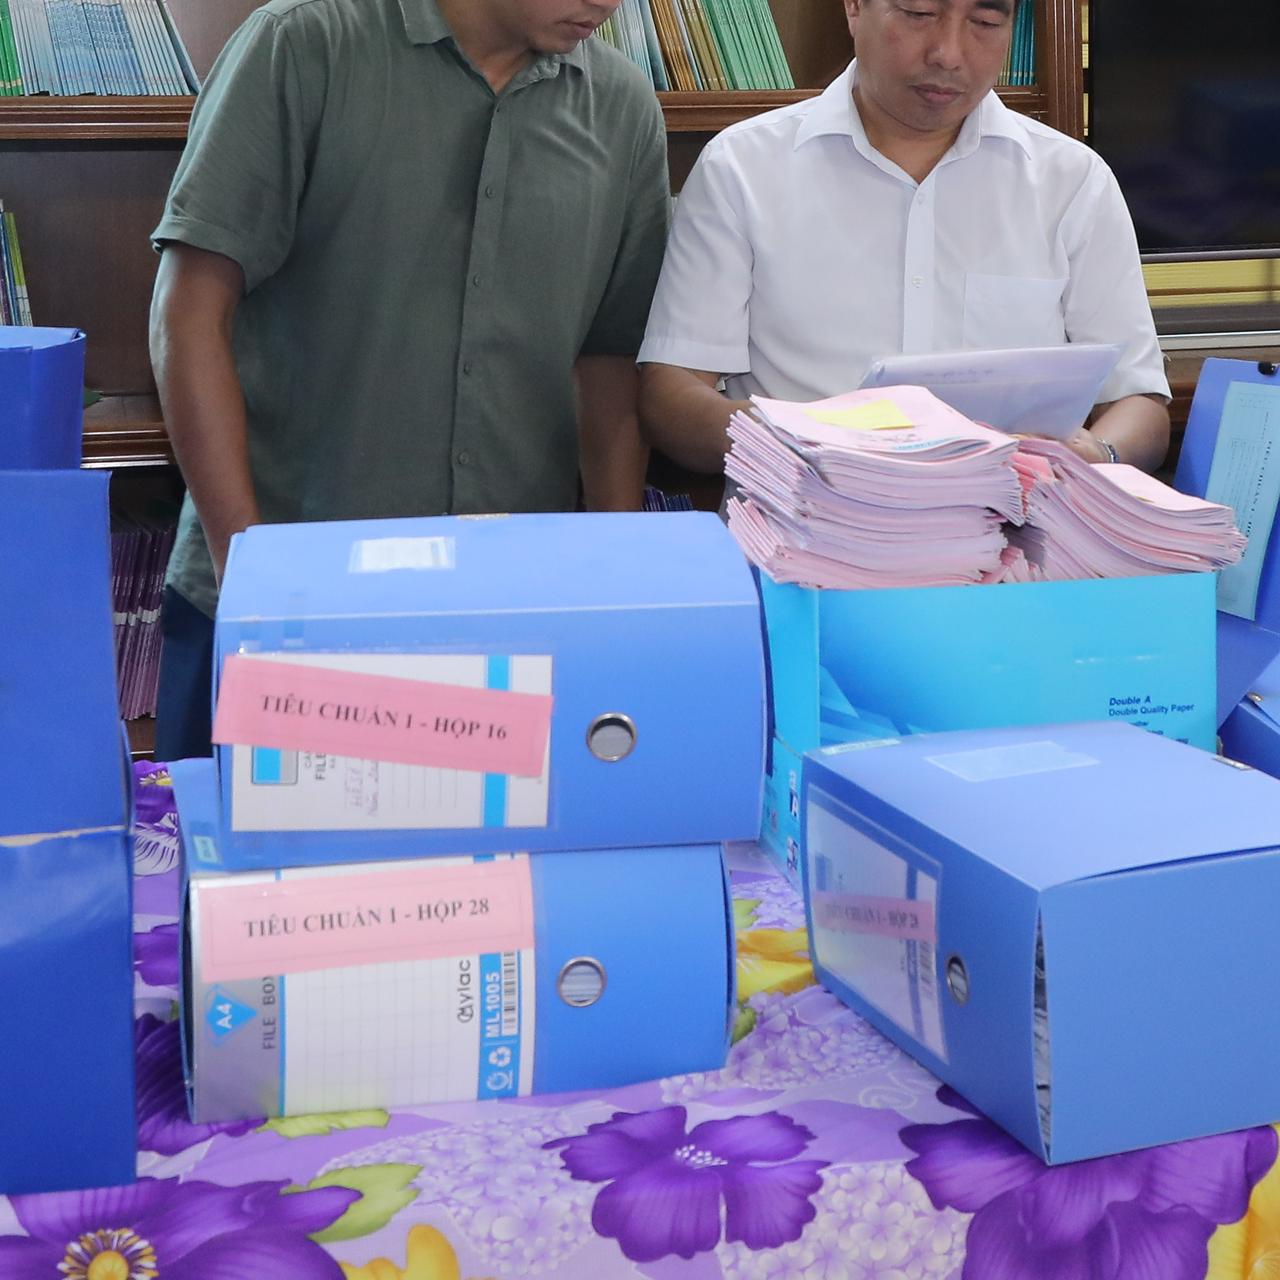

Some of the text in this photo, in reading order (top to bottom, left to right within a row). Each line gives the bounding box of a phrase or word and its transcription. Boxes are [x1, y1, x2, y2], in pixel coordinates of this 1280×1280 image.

[260, 693, 311, 716] TIÊU
[434, 717, 480, 738] HỘP
[487, 723, 507, 740] 16
[1109, 695, 1152, 706] Double A
[1109, 704, 1195, 716] Double Quality Paper
[245, 914, 296, 938] TIÊU
[418, 899, 463, 923] HỘP
[469, 898, 490, 916] 28
[216, 1003, 233, 1029] A4
[485, 971, 501, 1039] ML1005
[262, 1017, 276, 1050] FILE
